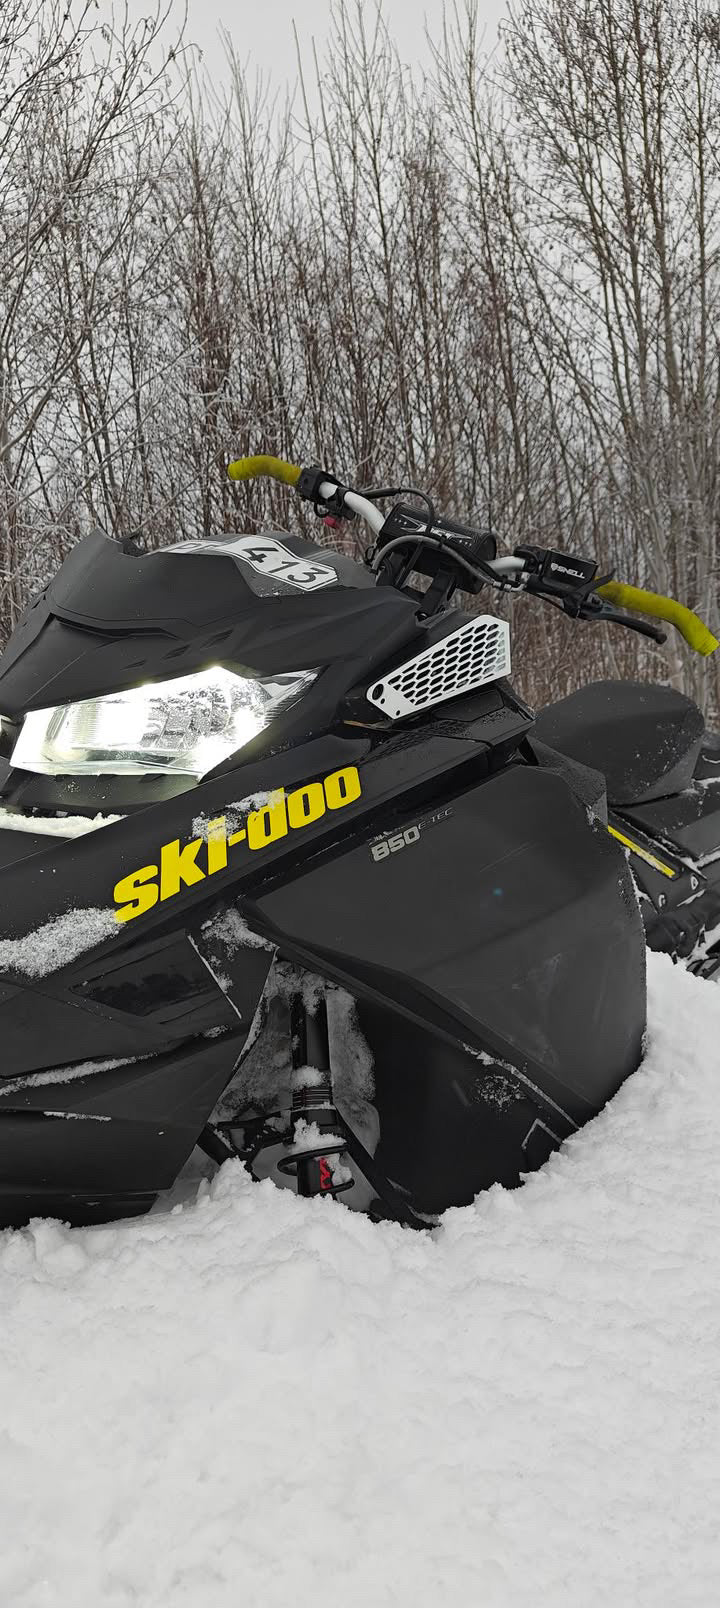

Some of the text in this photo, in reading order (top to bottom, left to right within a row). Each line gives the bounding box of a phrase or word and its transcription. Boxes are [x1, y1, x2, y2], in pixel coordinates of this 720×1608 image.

[242, 546, 330, 583] 413
[557, 565, 586, 579] SNELL
[113, 766, 362, 924] ski-doo
[371, 826, 421, 862] 850
